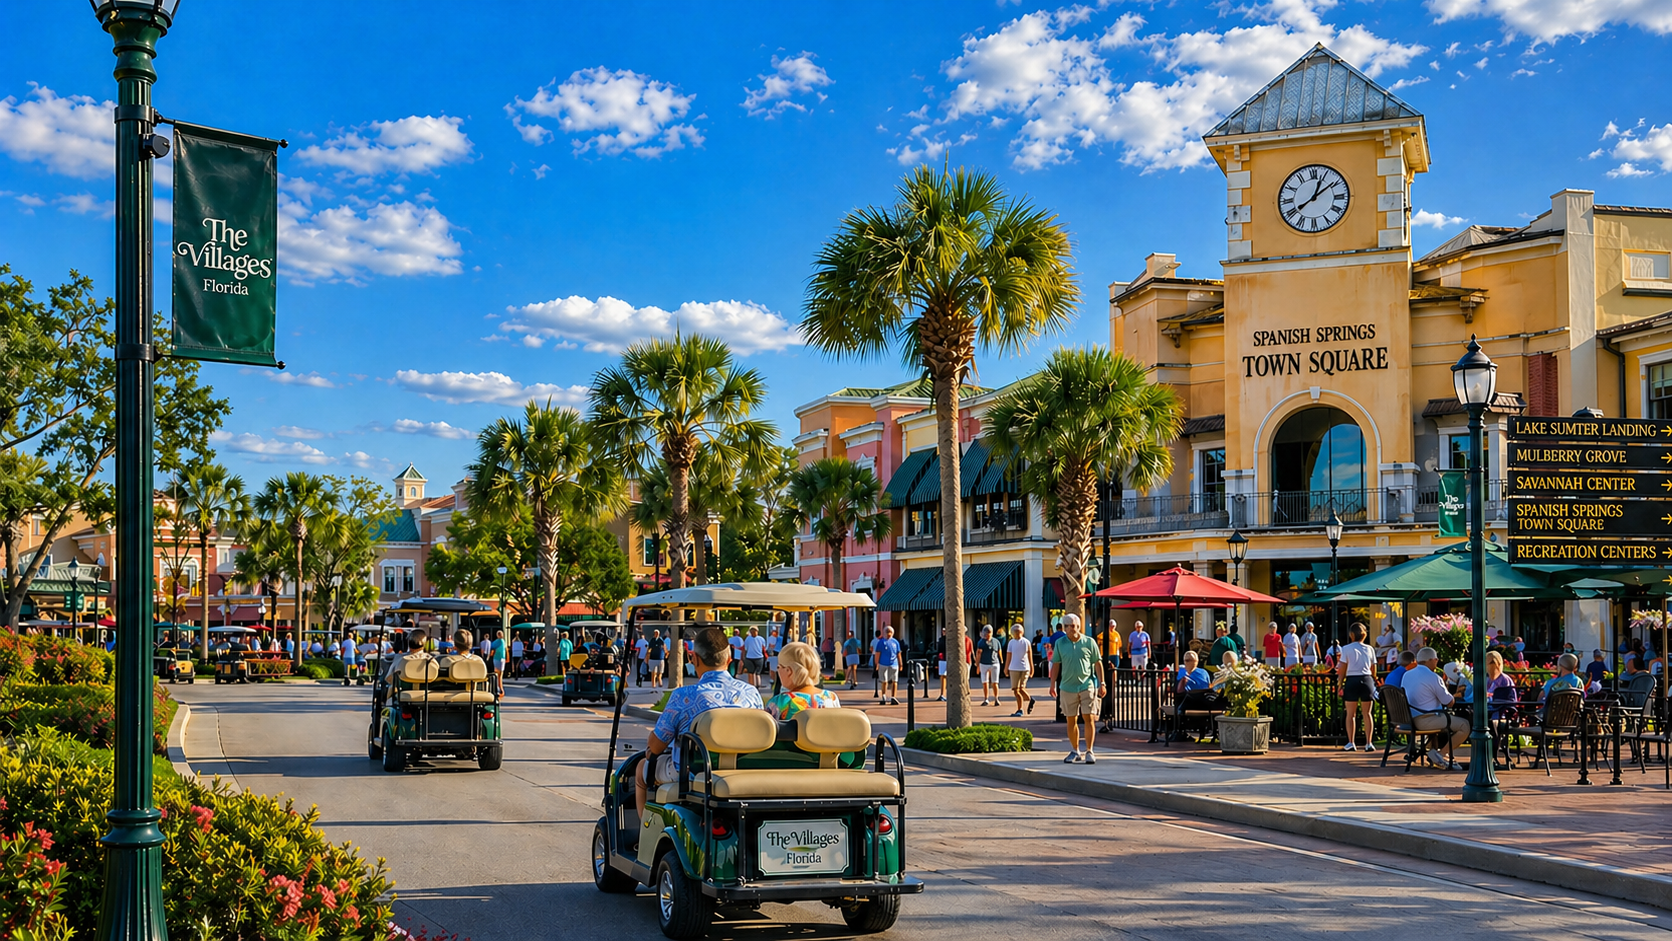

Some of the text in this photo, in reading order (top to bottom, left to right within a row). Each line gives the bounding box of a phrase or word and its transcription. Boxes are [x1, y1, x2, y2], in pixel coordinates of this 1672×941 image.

[202, 217, 248, 252] The
[177, 241, 273, 281] Villages
[203, 279, 249, 296] Florida
[1253, 323, 1376, 347] SPANISH SPRINGS
[1242, 346, 1389, 378] TOWN SQUARE
[1516, 421, 1657, 437] LAKE SUMTER LANDING
[1516, 449, 1627, 463] MULBERRY GROVE
[1516, 476, 1636, 491] SAVANNAH CENTER
[1516, 504, 1624, 518] SPANISH SPRINGS
[1517, 518, 1605, 534] TOWN SQUARE
[1517, 545, 1657, 559] RECREATION CENTERS
[766, 829, 840, 850] The Villages
[786, 852, 822, 865] Florida
